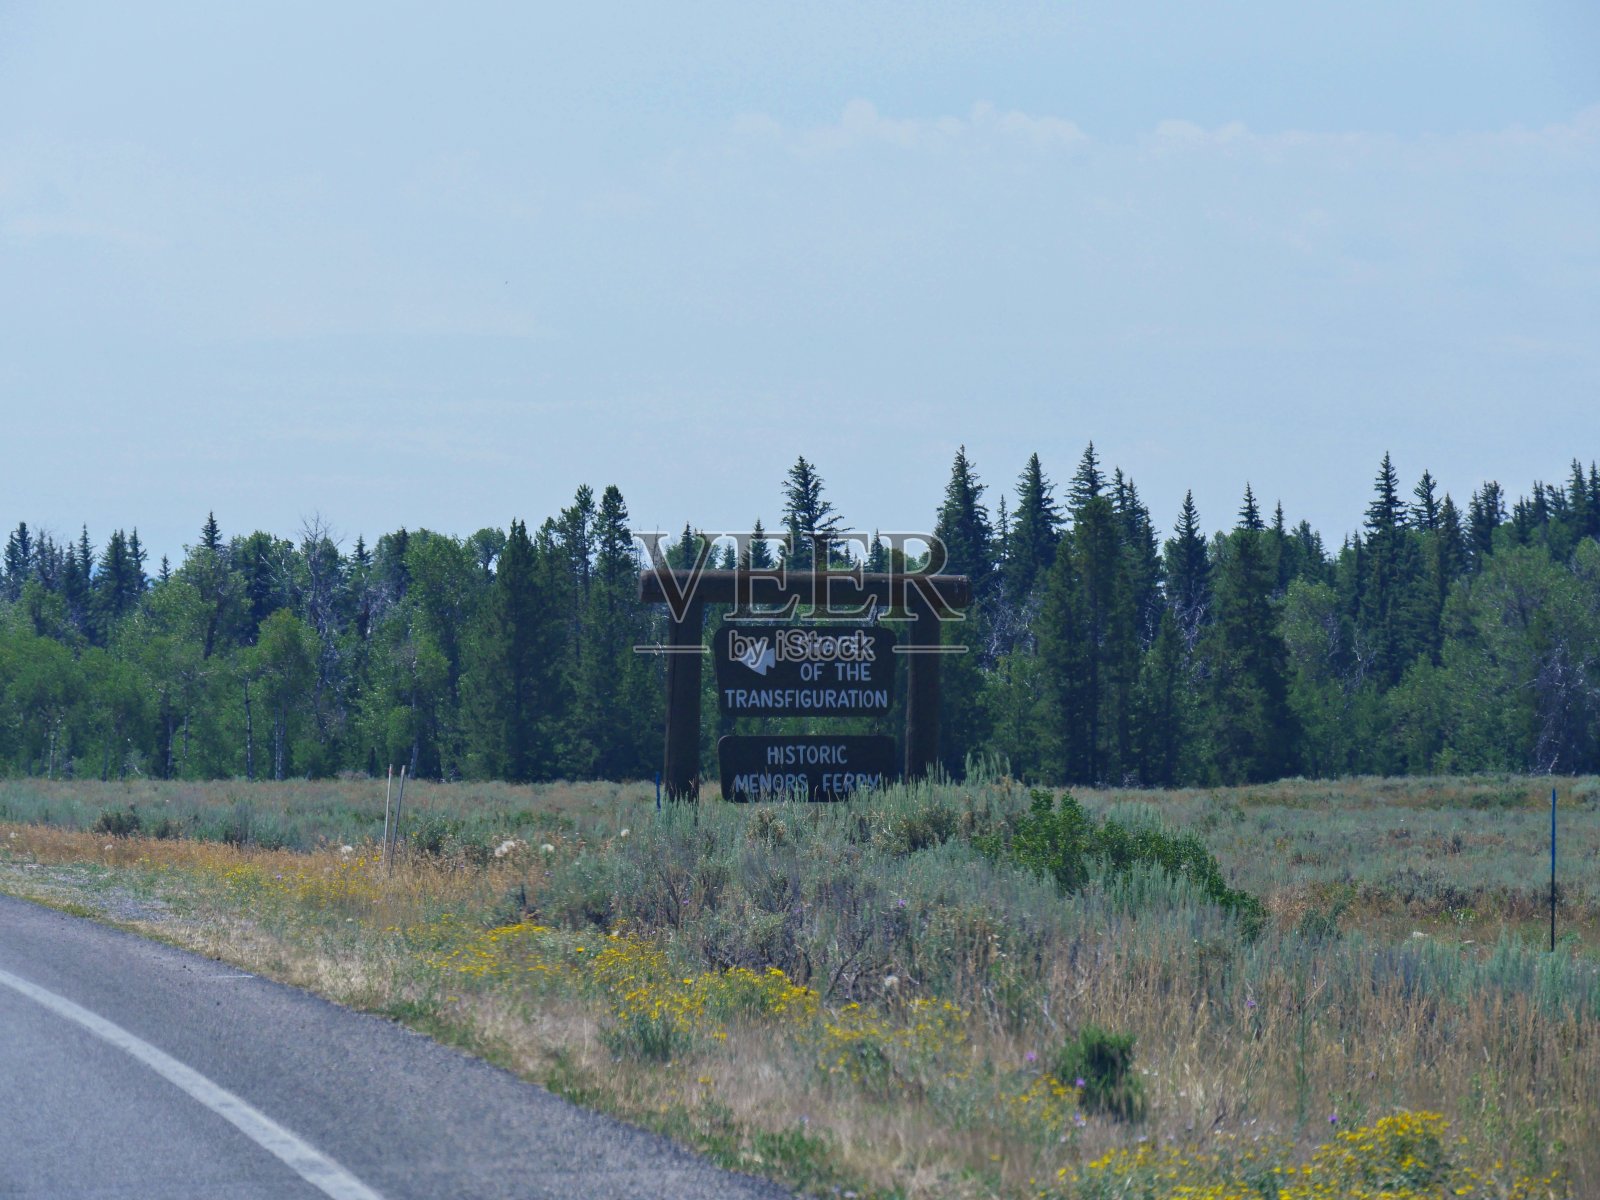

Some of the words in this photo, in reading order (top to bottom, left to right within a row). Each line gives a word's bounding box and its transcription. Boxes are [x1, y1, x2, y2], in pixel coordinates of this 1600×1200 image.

[800, 662, 825, 681] OF
[834, 662, 872, 681] THE
[724, 689, 888, 709] TRANSFIGURATION
[766, 745, 848, 765] HISTORIC
[734, 773, 808, 793] MENORS
